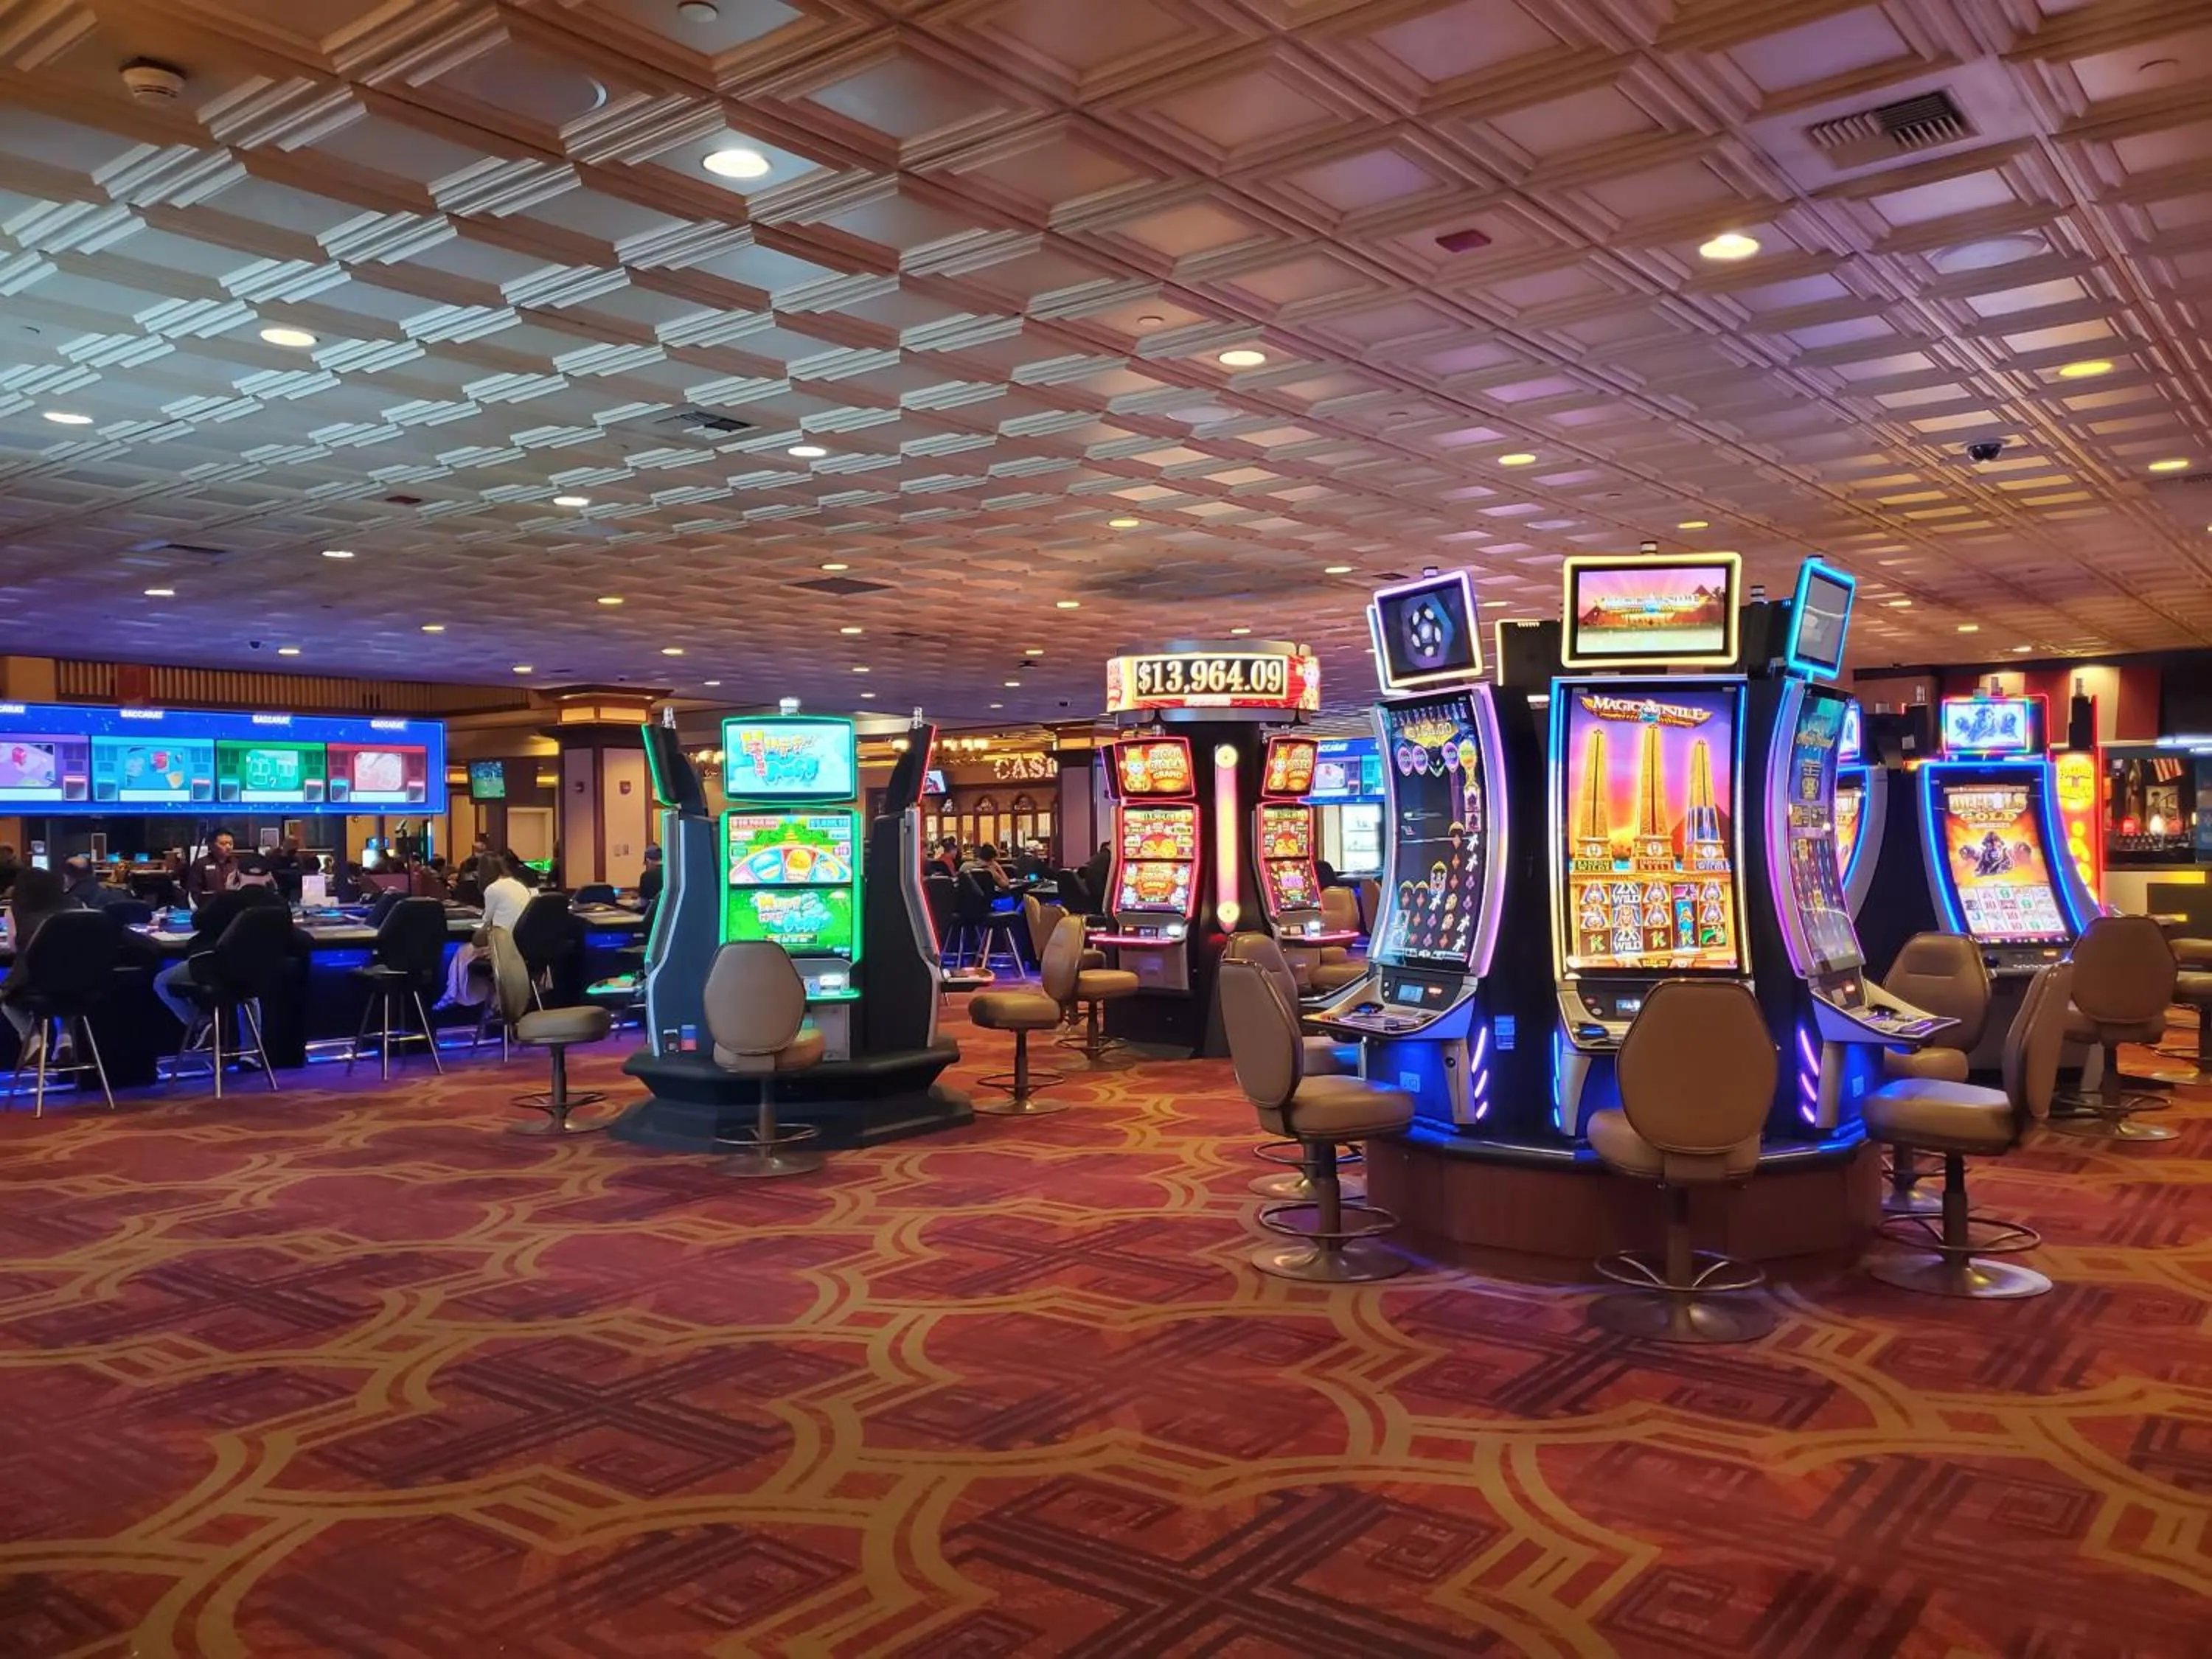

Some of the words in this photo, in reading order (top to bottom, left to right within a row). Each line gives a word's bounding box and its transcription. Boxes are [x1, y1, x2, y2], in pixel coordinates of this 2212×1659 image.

[1138, 660, 1281, 693] $13,964.09
[1593, 695, 1643, 712] MAGIC
[120, 709, 164, 719] BACCARAT
[1612, 894, 1641, 904] WILD
[1614, 941, 1641, 950] WILD
